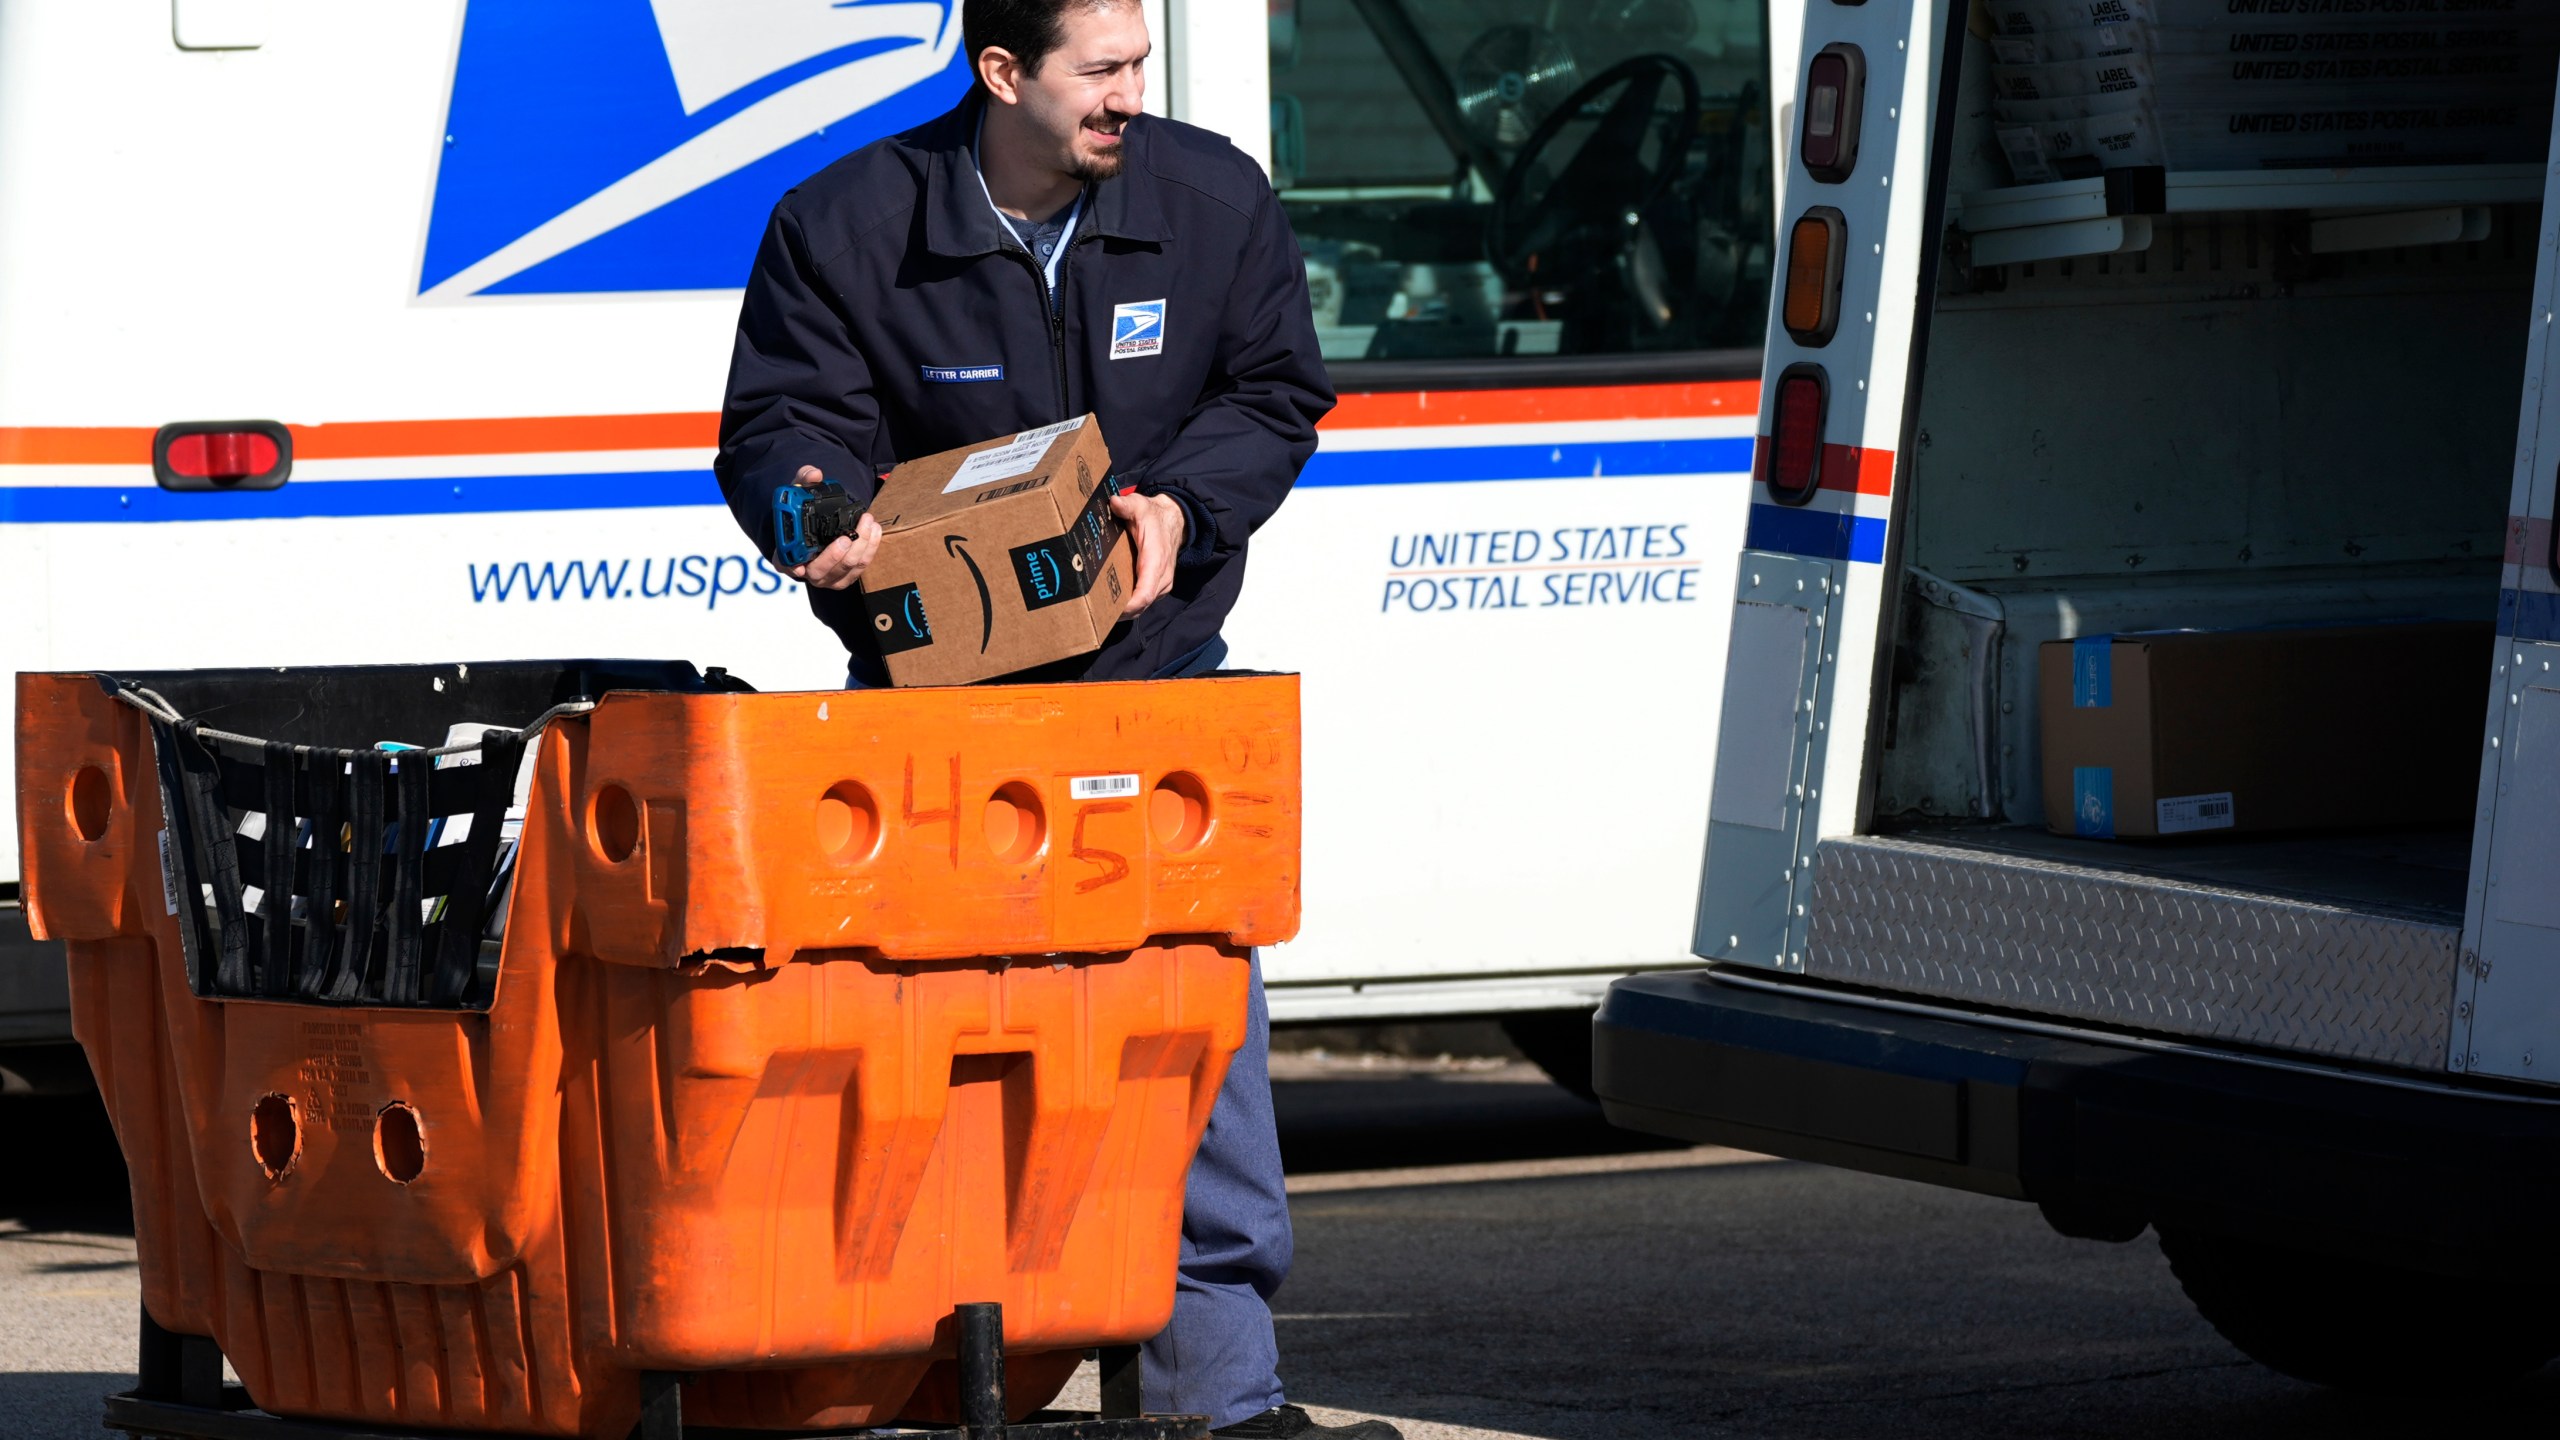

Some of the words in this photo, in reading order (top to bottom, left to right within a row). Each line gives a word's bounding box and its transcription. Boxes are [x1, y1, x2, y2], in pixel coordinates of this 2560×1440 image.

[2088, 0, 2126, 16] LABEL
[2228, 0, 2293, 13] UNITED
[2297, 0, 2366, 13] STATES
[2370, 0, 2438, 12] POSTAL
[2230, 33, 2297, 51] UNITED
[2301, 33, 2368, 51] STATES
[2372, 32, 2439, 50] POSTAL
[2444, 30, 2518, 48] SERVICE
[2096, 67, 2133, 83] LABEL
[2233, 61, 2300, 79] UNITED
[2302, 60, 2371, 79] STATES
[2374, 58, 2442, 77] POSTAL
[2447, 55, 2521, 74] SERVICE
[2229, 114, 2296, 133] UNITED
[2300, 112, 2367, 132] STATES
[2371, 110, 2440, 130] POSTAL
[2444, 107, 2518, 127] SERVICE
[2347, 143, 2404, 154] WARNING
[1138, 338, 1157, 346] STATES
[926, 370, 957, 380] LETTER
[960, 368, 999, 379] CARRIER
[1390, 530, 1540, 568] UNITED
[1548, 524, 1688, 562] STATES
[1026, 551, 1053, 600] prime
[1381, 575, 1529, 614] POSTAL
[1540, 568, 1700, 607] SERVICE
[904, 751, 961, 870] 4
[1072, 802, 1133, 895] 5
